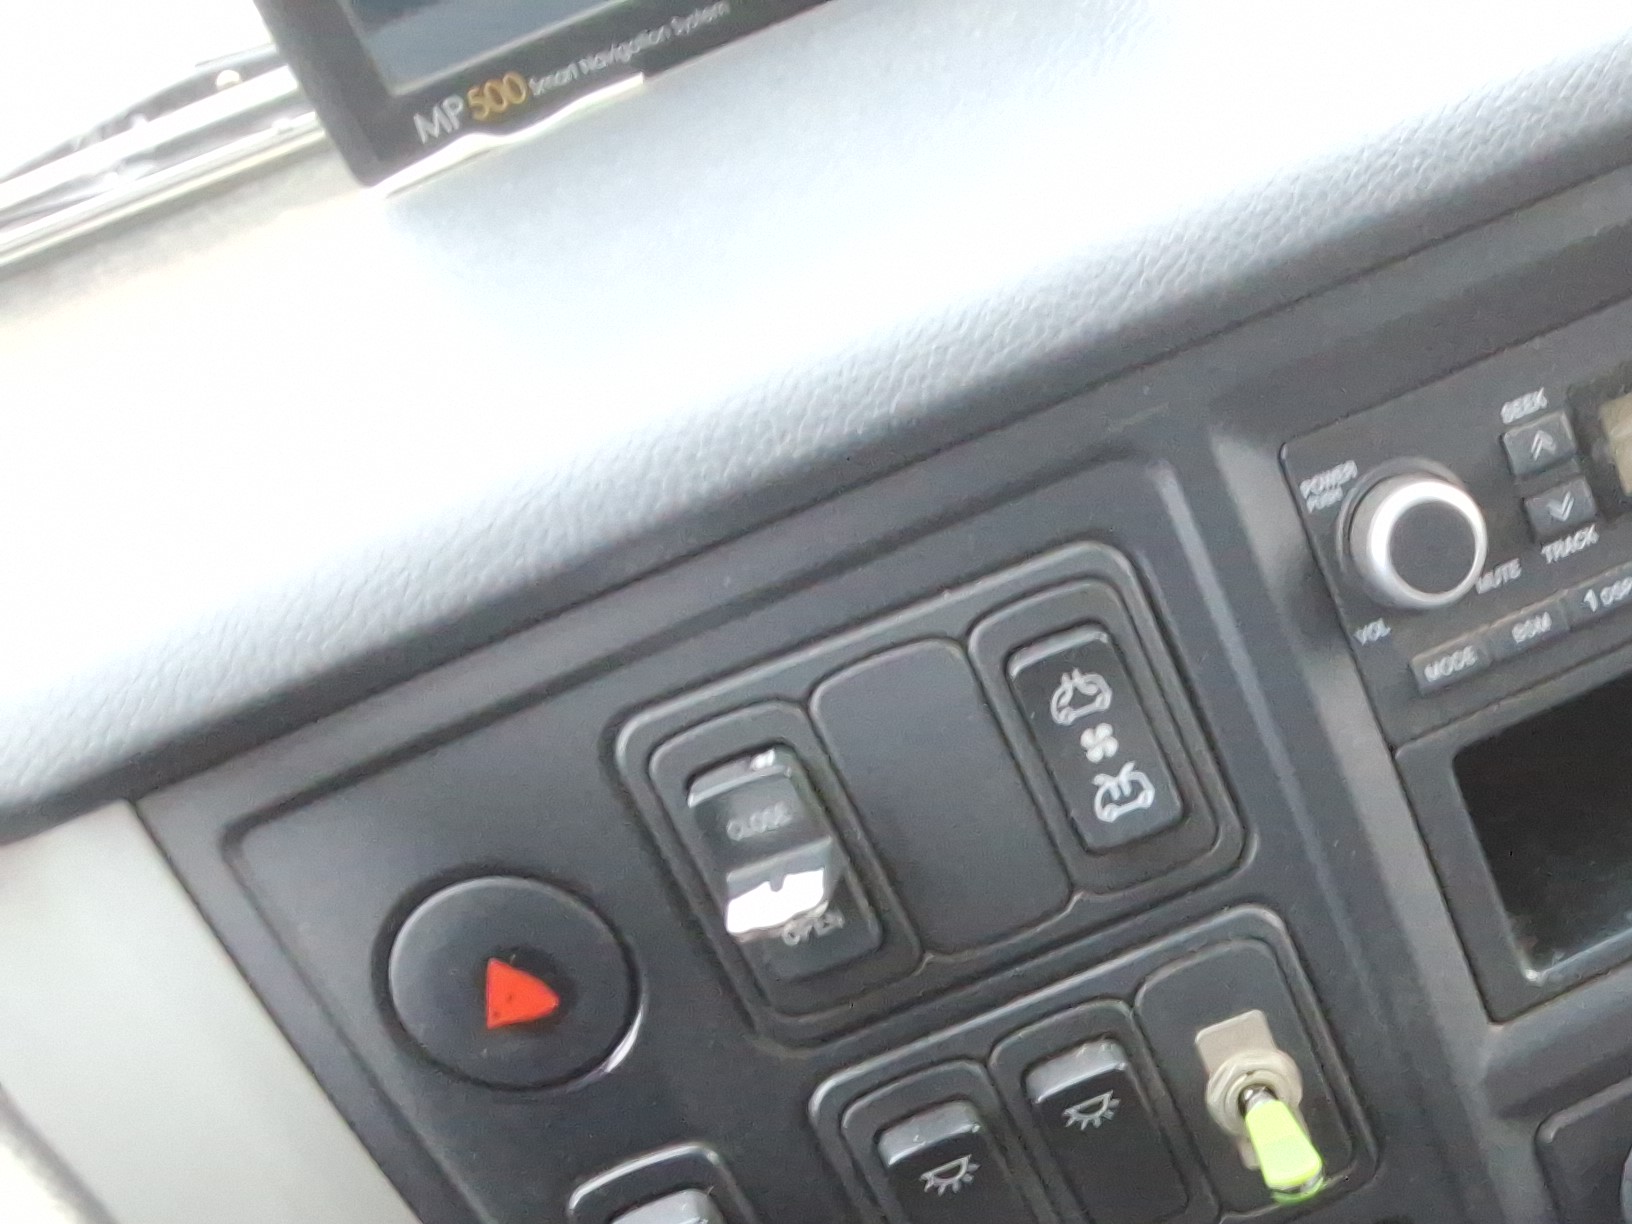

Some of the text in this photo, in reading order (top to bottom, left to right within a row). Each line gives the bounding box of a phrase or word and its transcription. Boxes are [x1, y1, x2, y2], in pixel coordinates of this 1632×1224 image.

[1541, 524, 1599, 563] TRACK
[1583, 588, 1599, 612] 1
[1355, 618, 1392, 645] VOL
[1425, 645, 1479, 681] MODE
